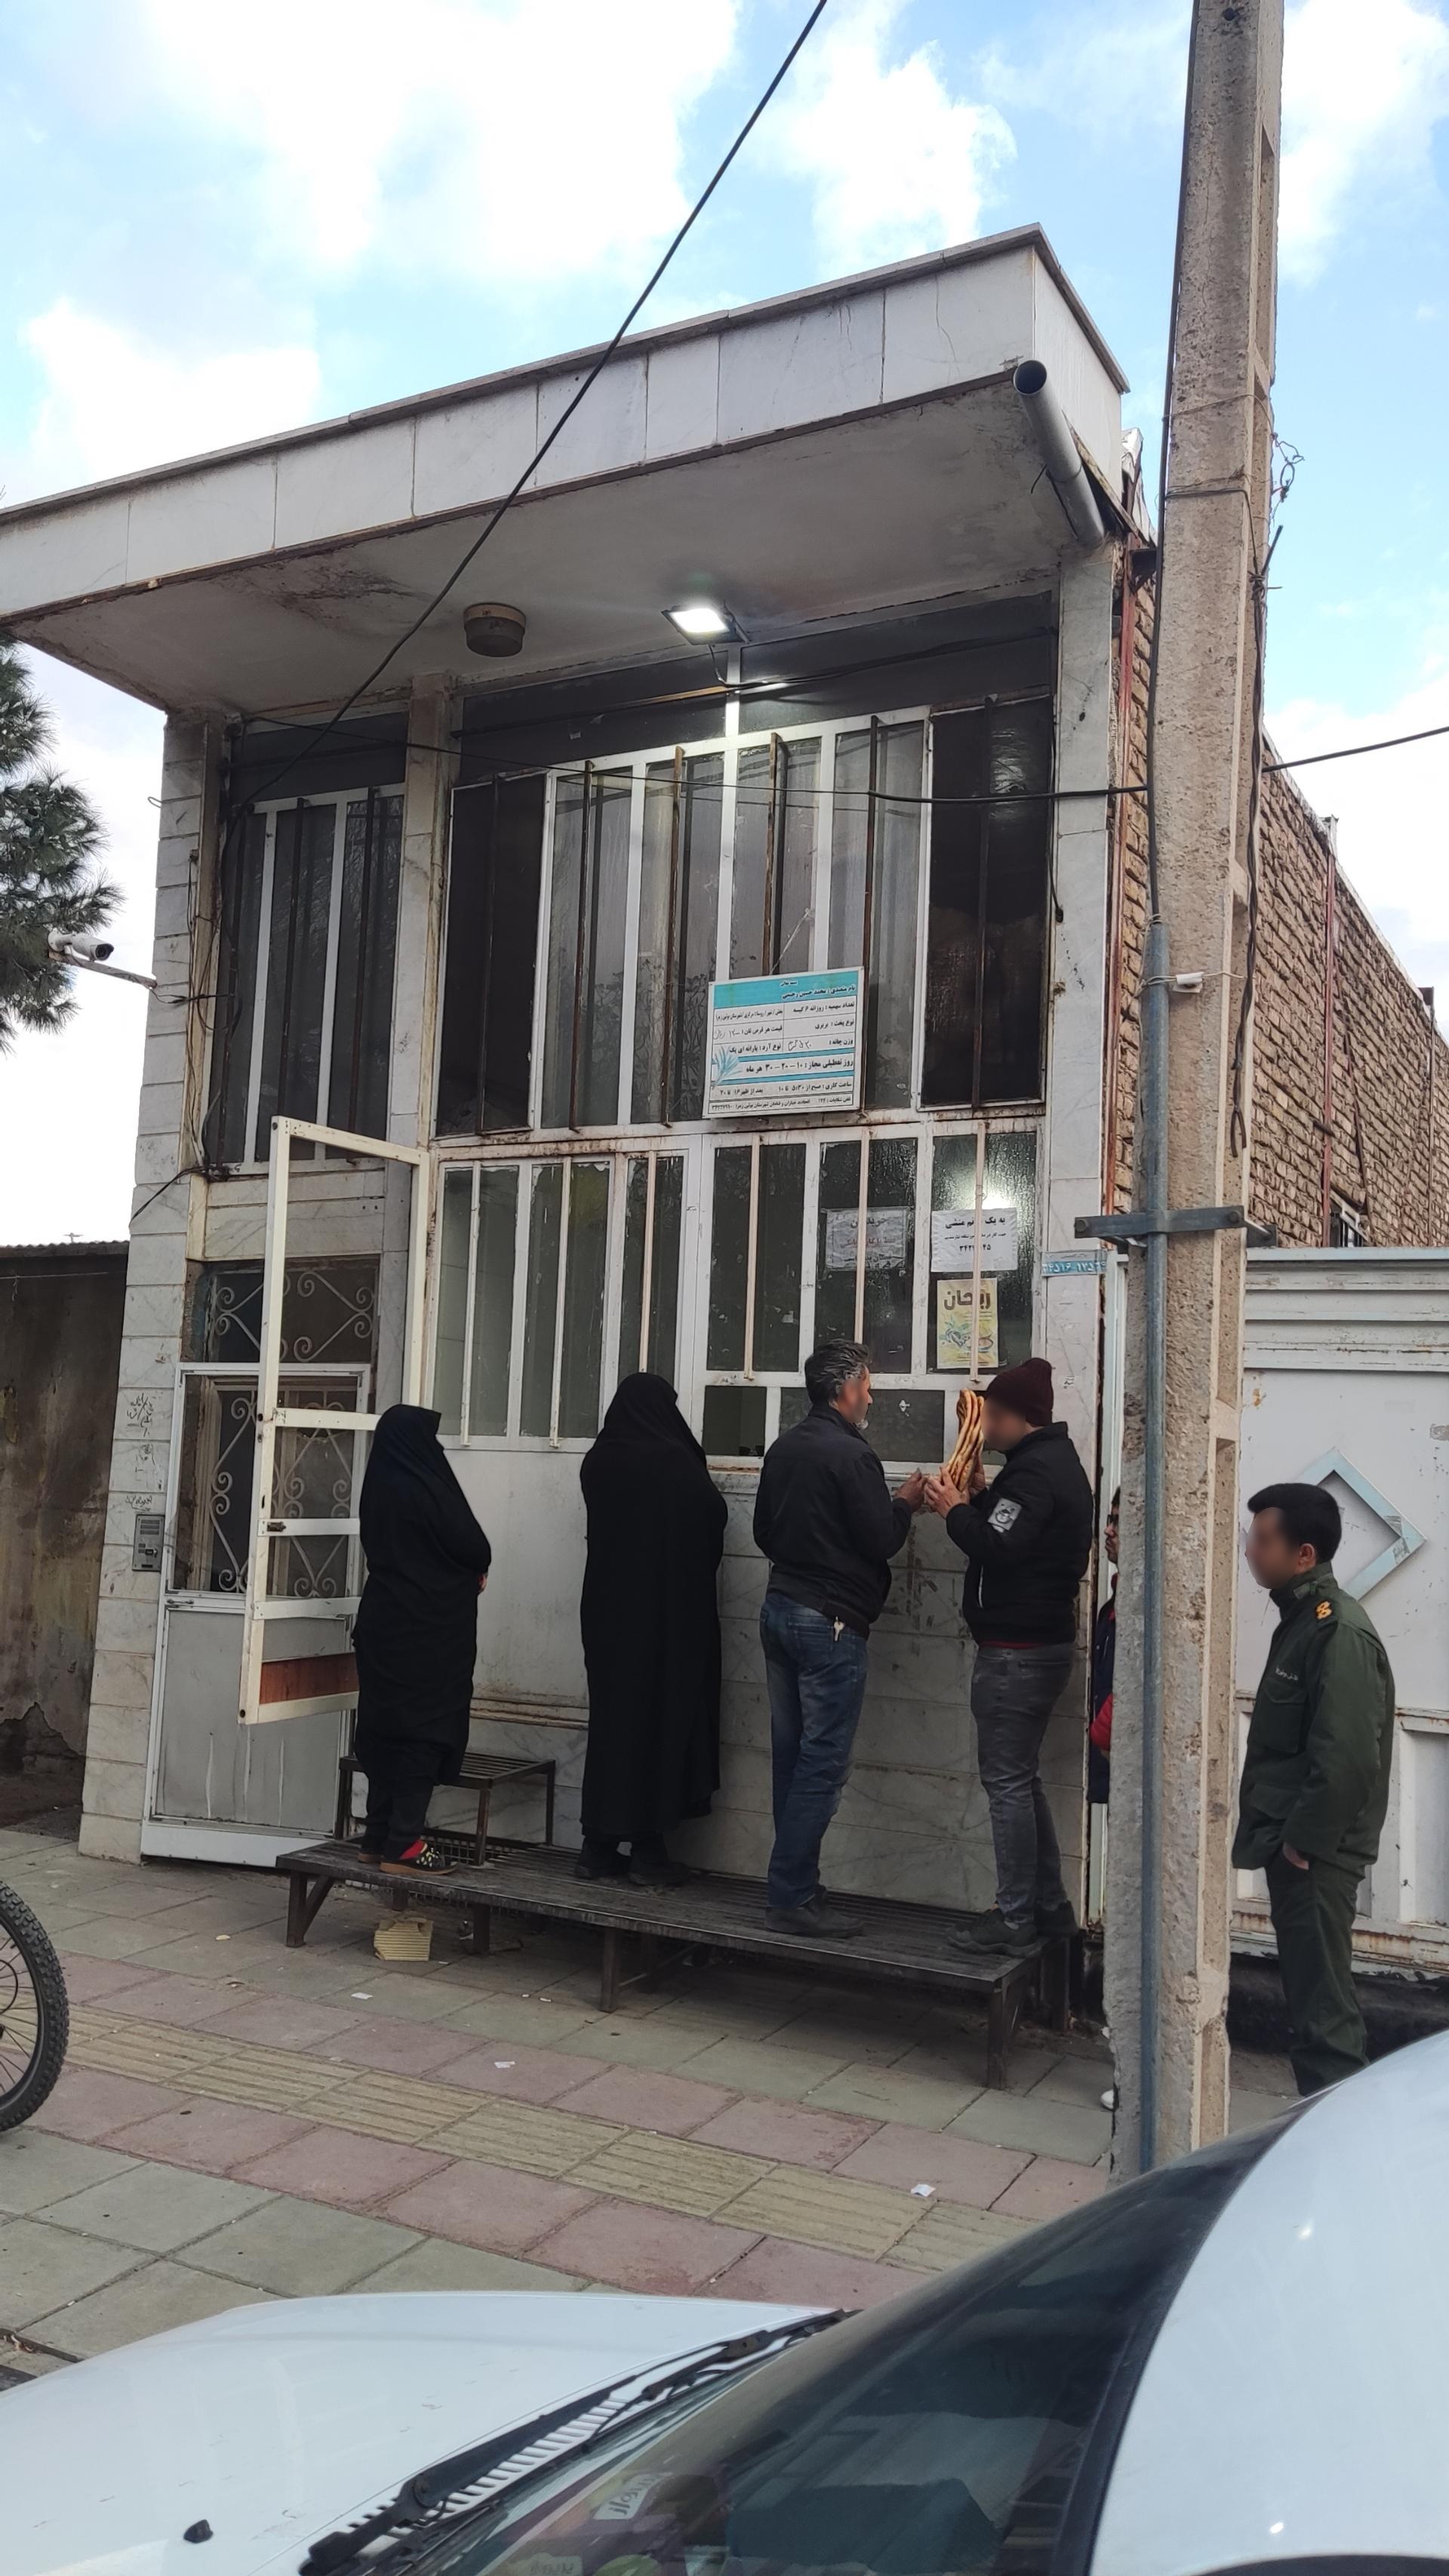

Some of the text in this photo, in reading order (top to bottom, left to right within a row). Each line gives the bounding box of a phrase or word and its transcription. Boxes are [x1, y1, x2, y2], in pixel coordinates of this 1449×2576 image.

[762, 1042, 771, 1051] آرد
[808, 1060, 821, 1070] مجاز
[823, 1058, 842, 1068] تعطیلی
[985, 1216, 996, 1226] یک
